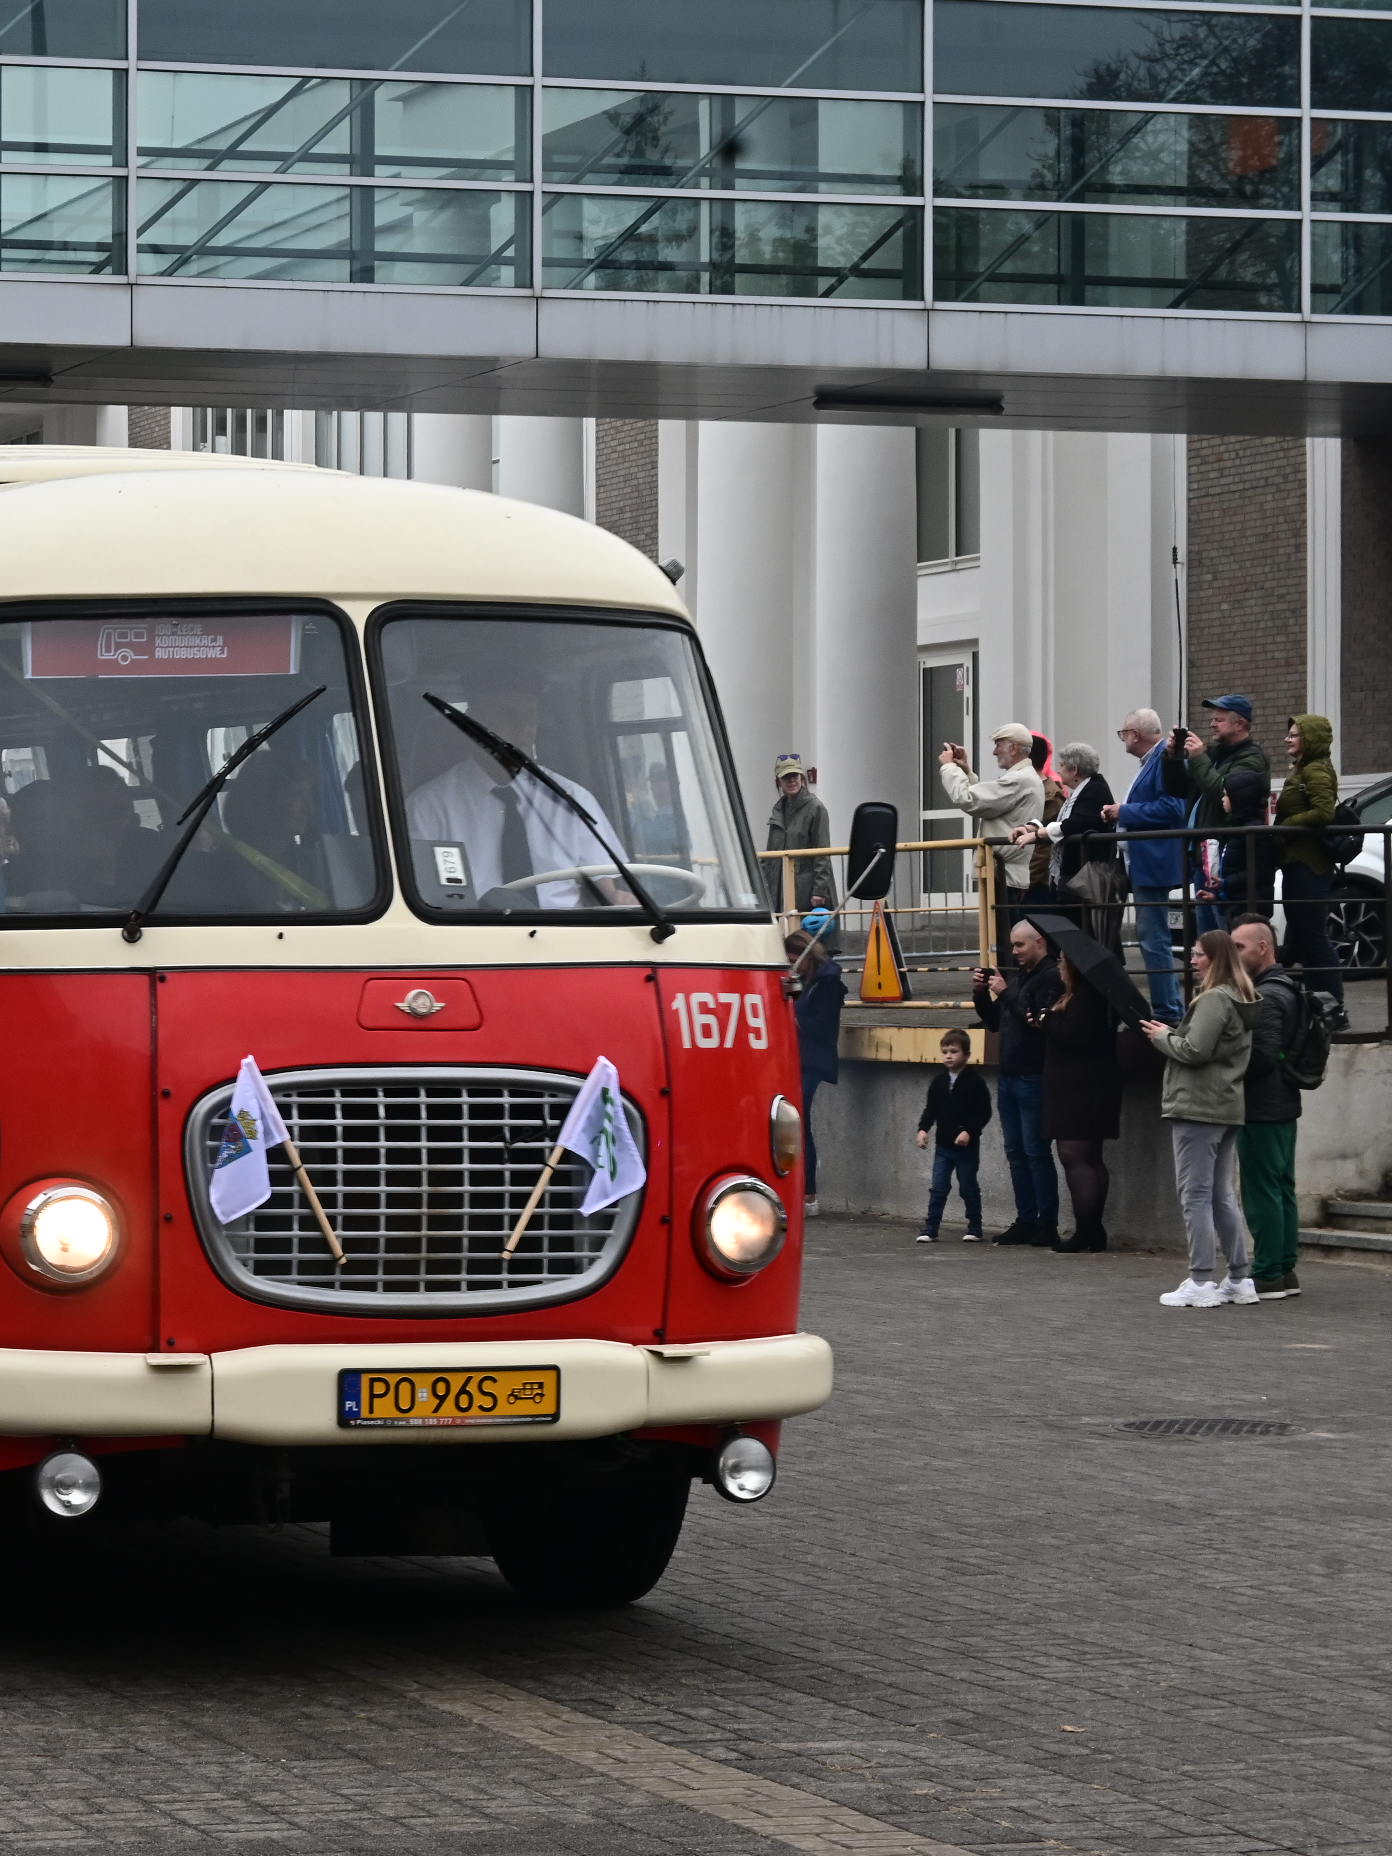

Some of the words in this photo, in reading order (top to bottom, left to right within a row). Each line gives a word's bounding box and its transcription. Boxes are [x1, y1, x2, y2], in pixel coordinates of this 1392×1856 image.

[155, 635, 224, 647] KOMUNIKACJI
[155, 647, 228, 659] AUTOBUSOWEJ
[671, 992, 769, 1050] 1679
[368, 1377, 416, 1414] PO
[431, 1376, 498, 1413] 96S
[345, 1401, 359, 1411] PL
